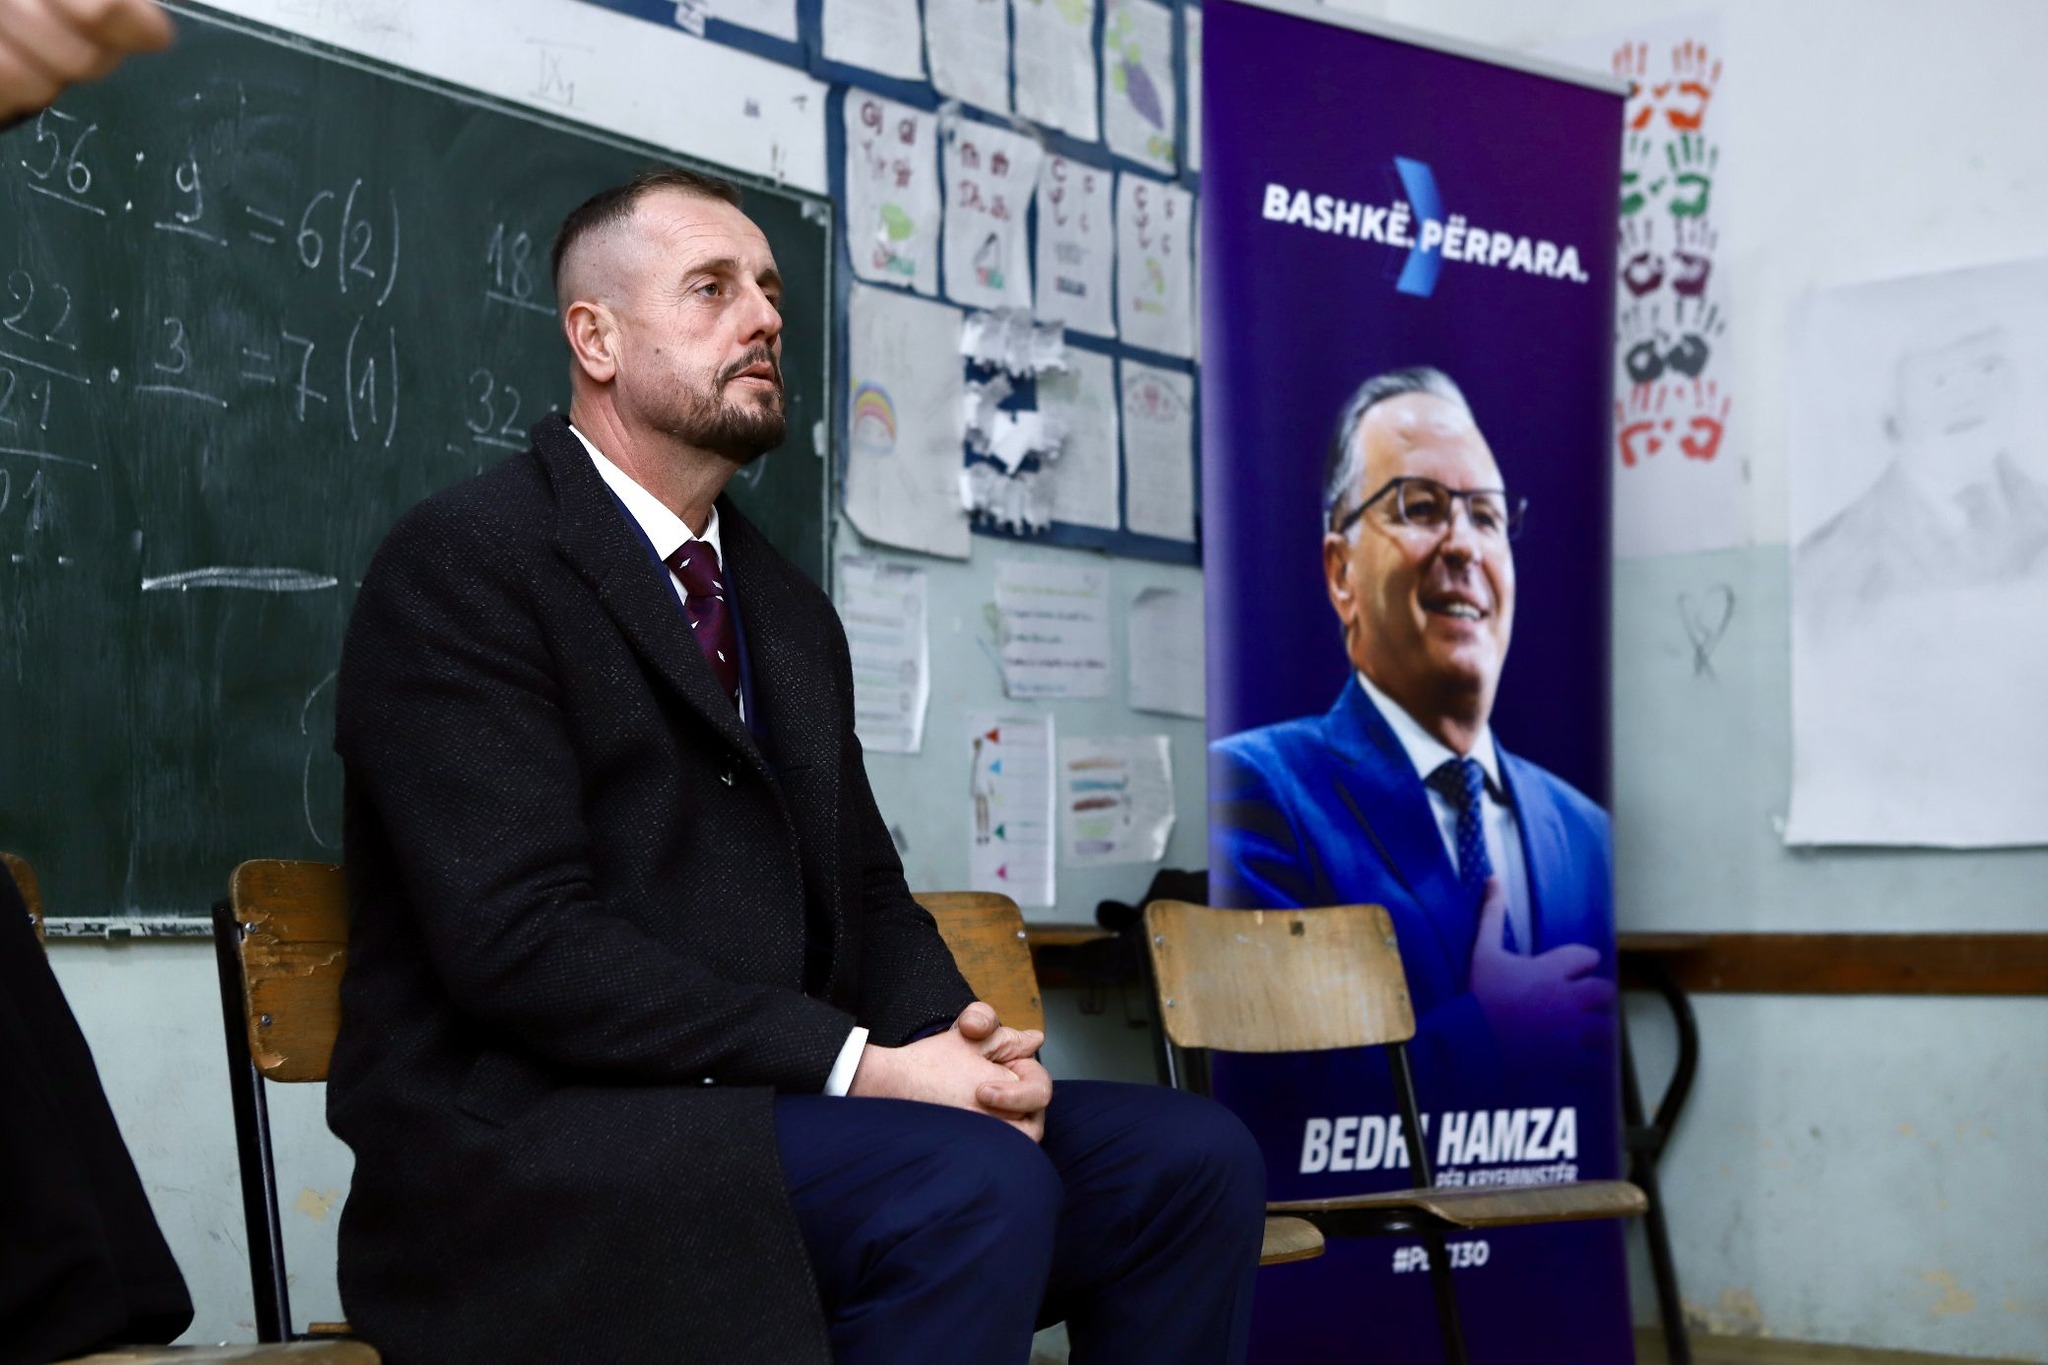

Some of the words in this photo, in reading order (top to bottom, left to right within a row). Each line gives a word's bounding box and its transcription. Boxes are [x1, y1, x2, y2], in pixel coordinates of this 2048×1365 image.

[20, 106, 99, 195] 56
[174, 156, 203, 224] 9
[486, 222, 533, 300] 18
[1263, 183, 1416, 249] BASHKË.
[1419, 214, 1590, 284] PËRPARA.
[2, 269, 77, 351] 22
[154, 316, 187, 374] 3
[466, 368, 527, 438] 32
[1436, 1106, 1578, 1167] HAMZA
